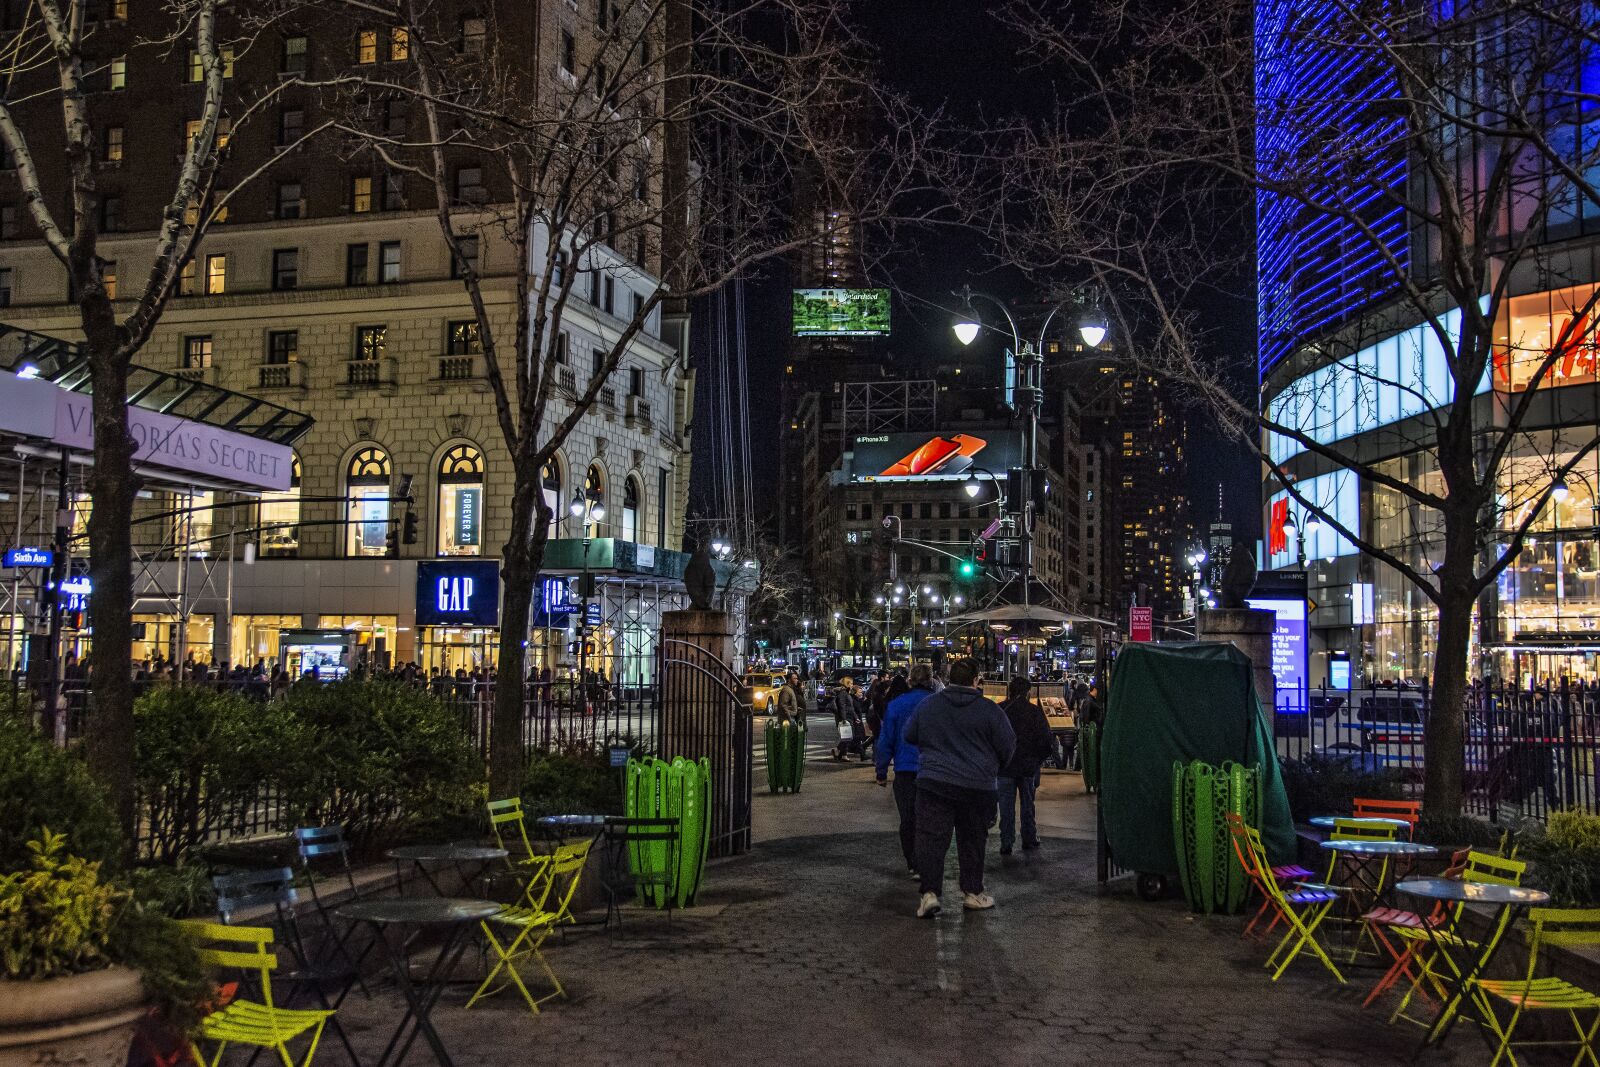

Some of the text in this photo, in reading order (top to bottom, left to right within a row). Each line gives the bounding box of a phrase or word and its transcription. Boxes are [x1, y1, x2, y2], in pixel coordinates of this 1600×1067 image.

[67, 403, 281, 479] VIORIA'S SECRET
[462, 493, 472, 543] FOREVER 21
[14, 552, 47, 563] Sixth Ave
[438, 577, 473, 611] GAP
[1132, 614, 1150, 622] NYC
[1285, 635, 1301, 643] your
[1281, 664, 1294, 673] you
